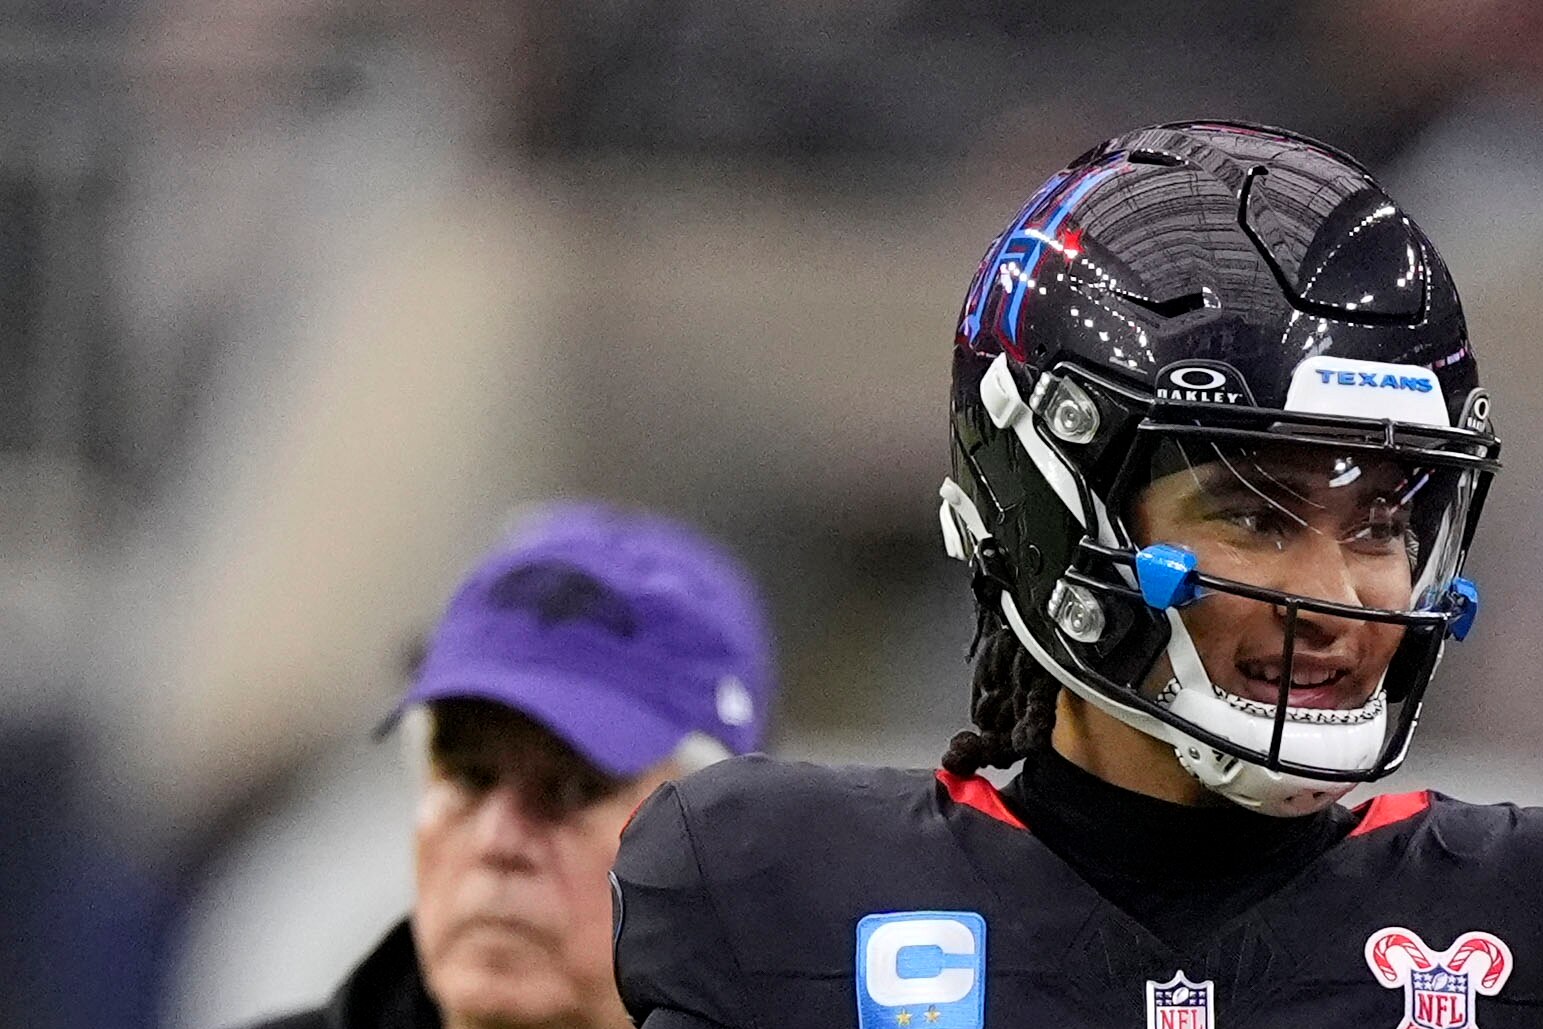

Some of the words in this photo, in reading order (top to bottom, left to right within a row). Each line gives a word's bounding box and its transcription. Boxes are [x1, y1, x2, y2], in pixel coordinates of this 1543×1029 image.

[1315, 369, 1433, 393] TEXANS
[1157, 388, 1240, 404] OAKLEY
[866, 919, 976, 1007] C
[1418, 993, 1463, 1027] NFL
